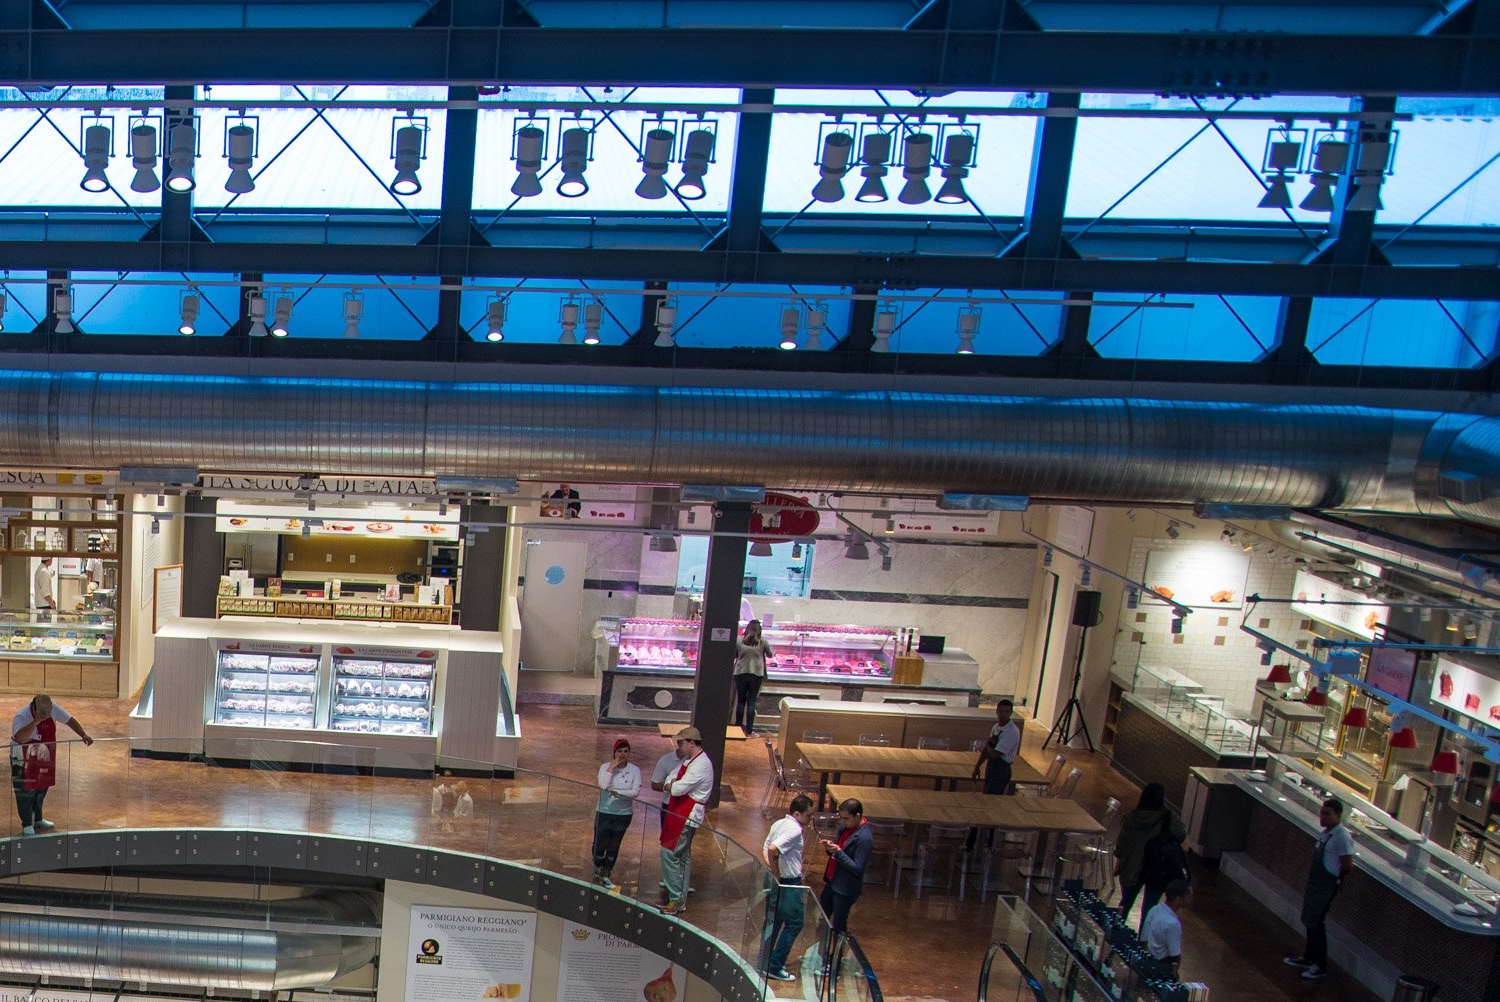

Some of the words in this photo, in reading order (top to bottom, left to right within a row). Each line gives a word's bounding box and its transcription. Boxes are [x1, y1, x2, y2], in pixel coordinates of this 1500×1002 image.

[210, 477, 234, 489] LA
[240, 477, 328, 492] SCUOA
[336, 479, 357, 493] DI
[420, 912, 475, 924] PARMIGIANO
[457, 925, 481, 934] QUEIJO
[1, 994, 11, 1002] IL
